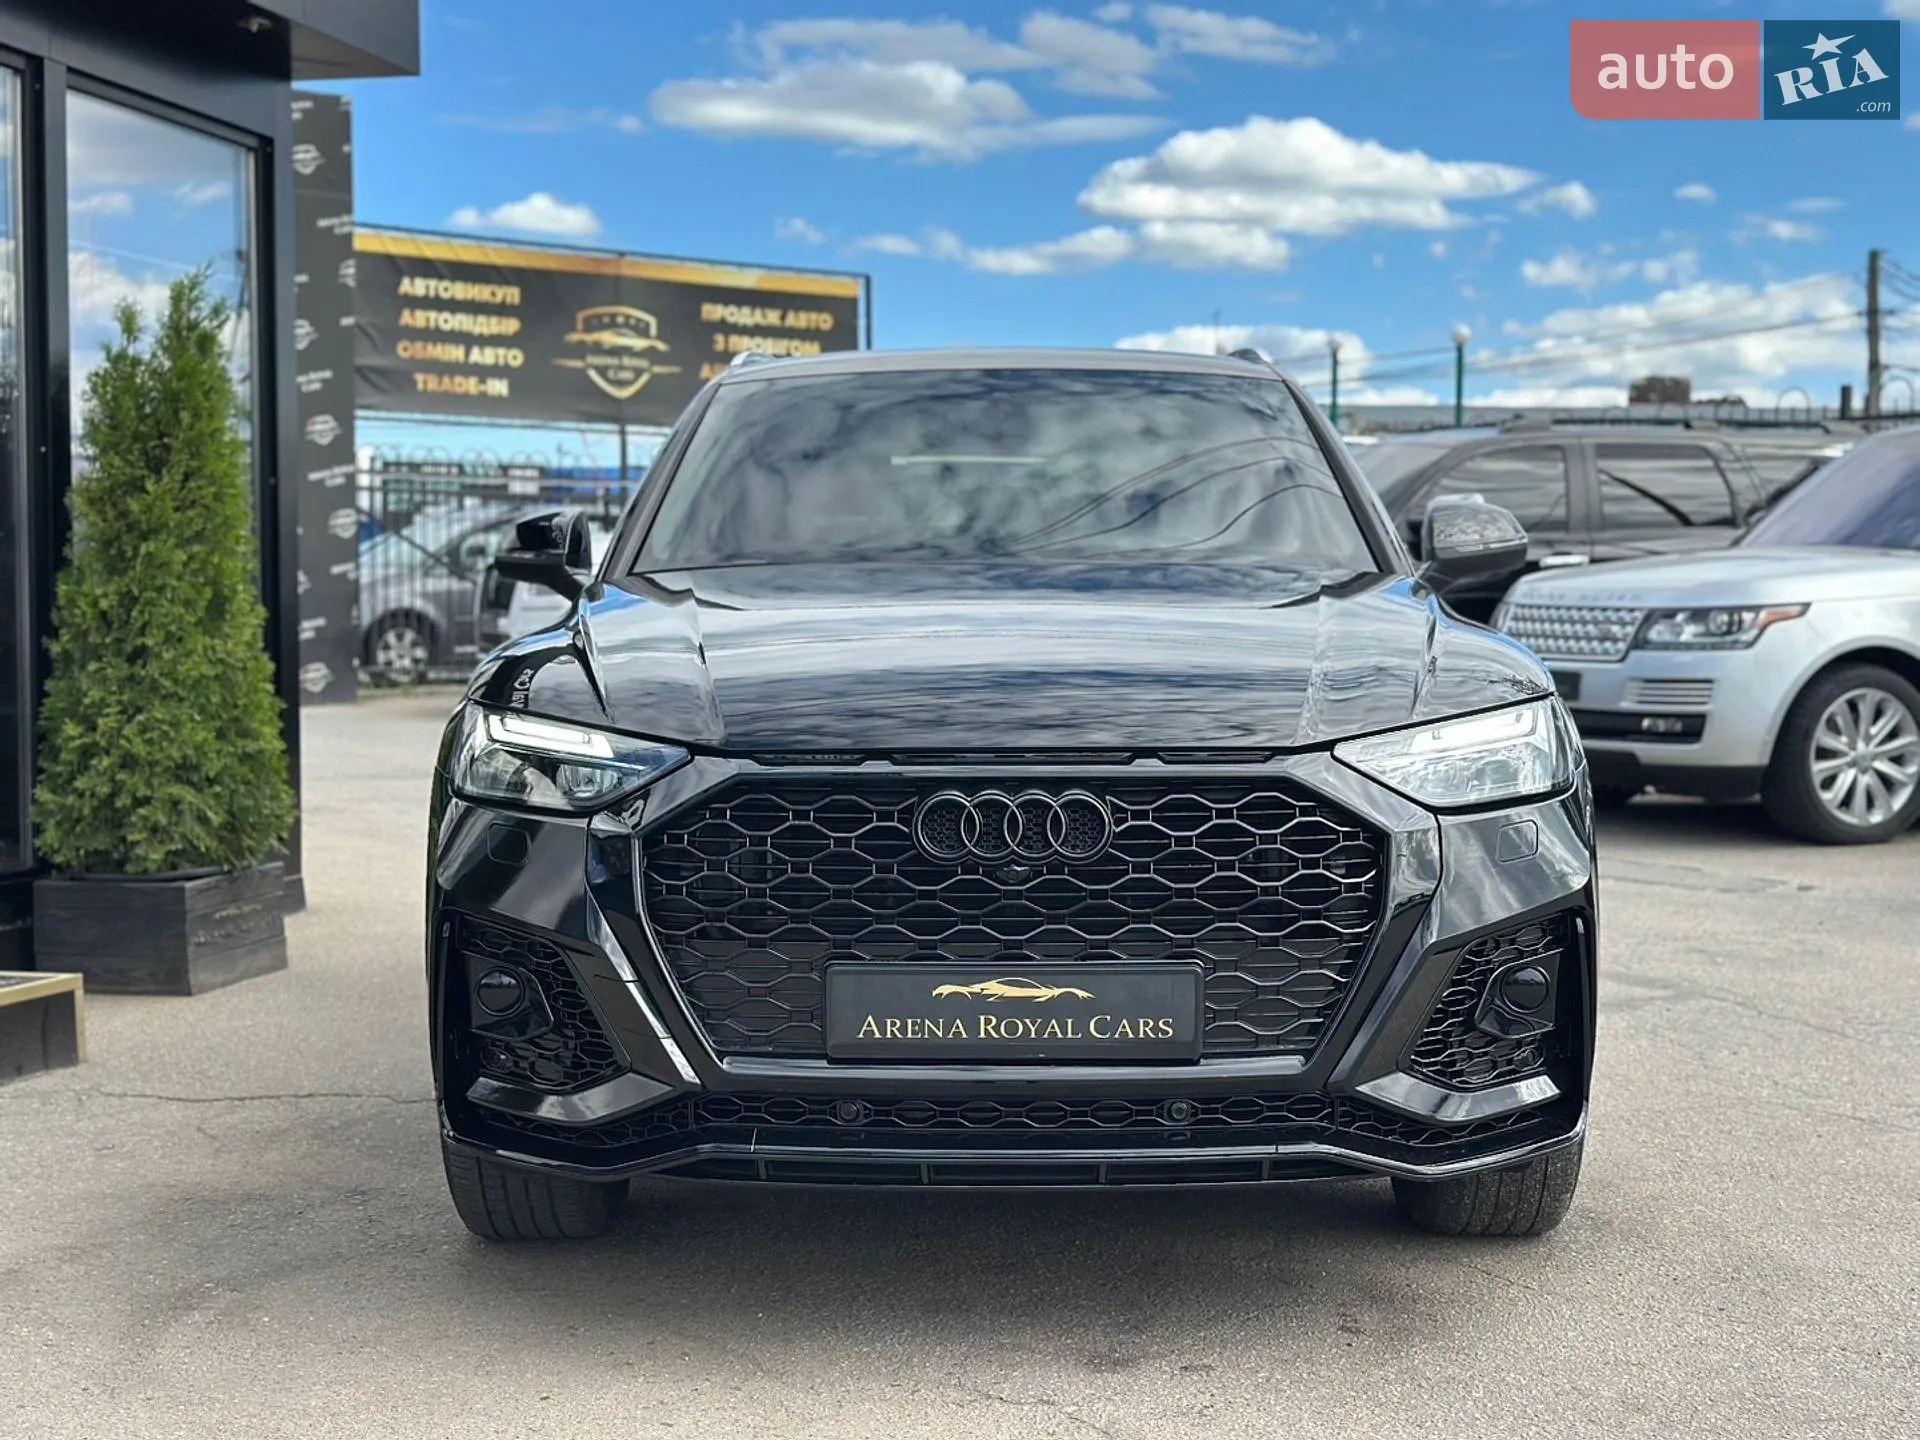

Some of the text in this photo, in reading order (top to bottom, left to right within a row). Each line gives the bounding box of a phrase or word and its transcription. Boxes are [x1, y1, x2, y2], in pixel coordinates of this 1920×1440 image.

[468, 345, 524, 368] АВТО
[414, 372, 509, 397] TRADE-IN
[856, 1014, 1174, 1040] ARENA ROYAL CARS
